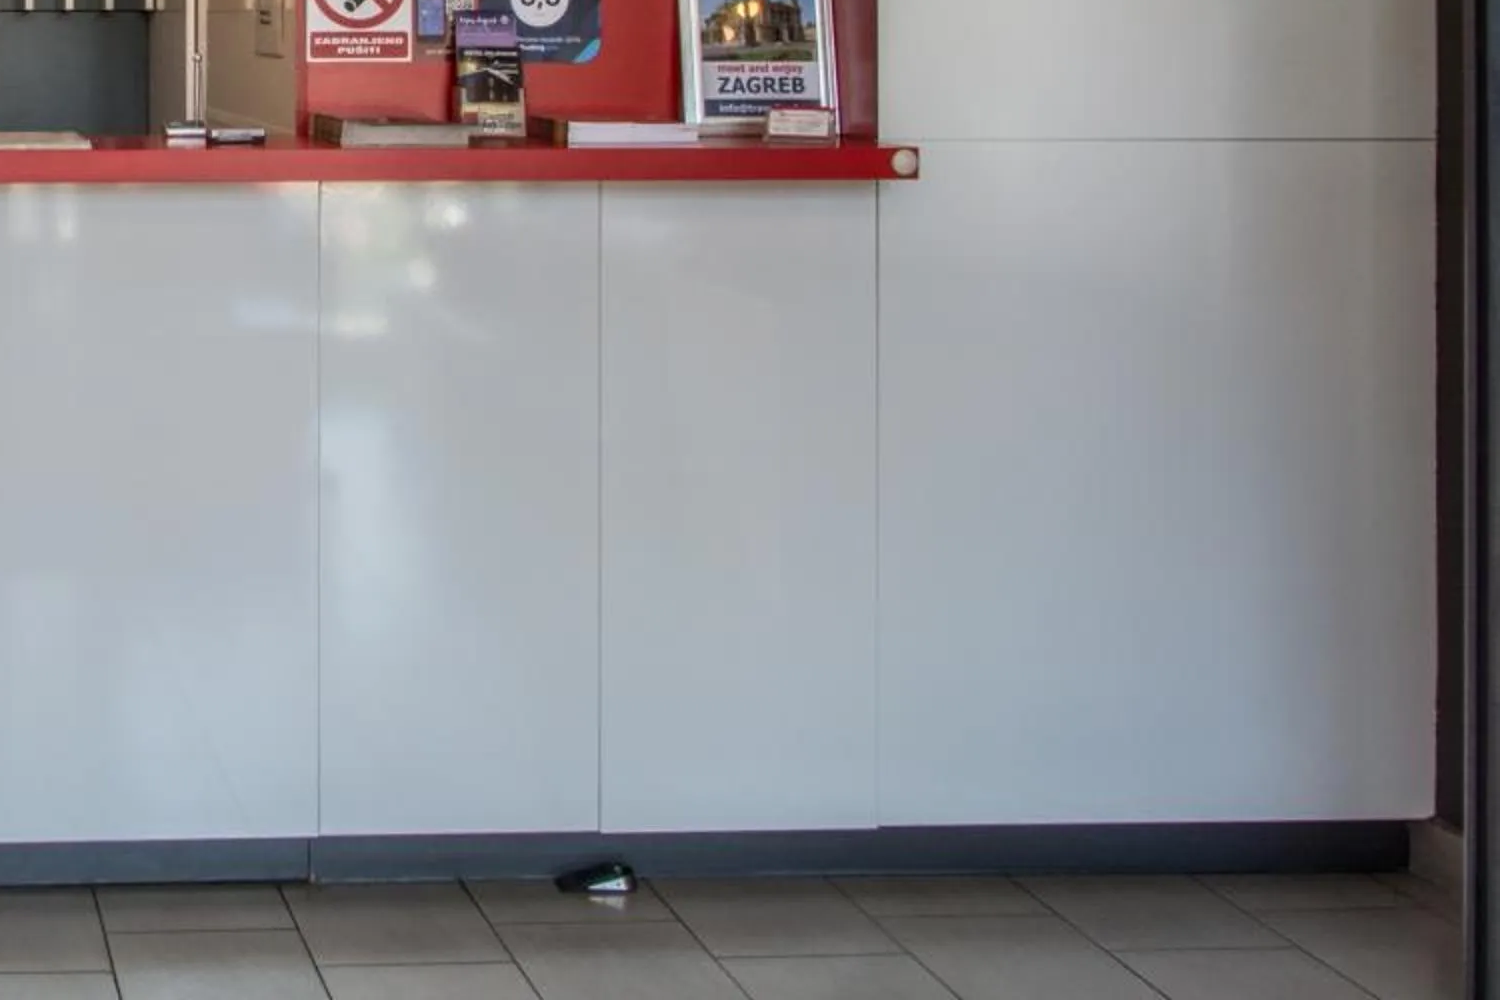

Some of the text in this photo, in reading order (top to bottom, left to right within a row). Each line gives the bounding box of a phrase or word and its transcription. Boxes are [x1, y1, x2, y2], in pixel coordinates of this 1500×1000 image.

[314, 36, 404, 45] ZABRANJENO
[748, 63, 769, 73] and
[771, 64, 804, 75] enjoy
[717, 76, 806, 94] ZAGREB
